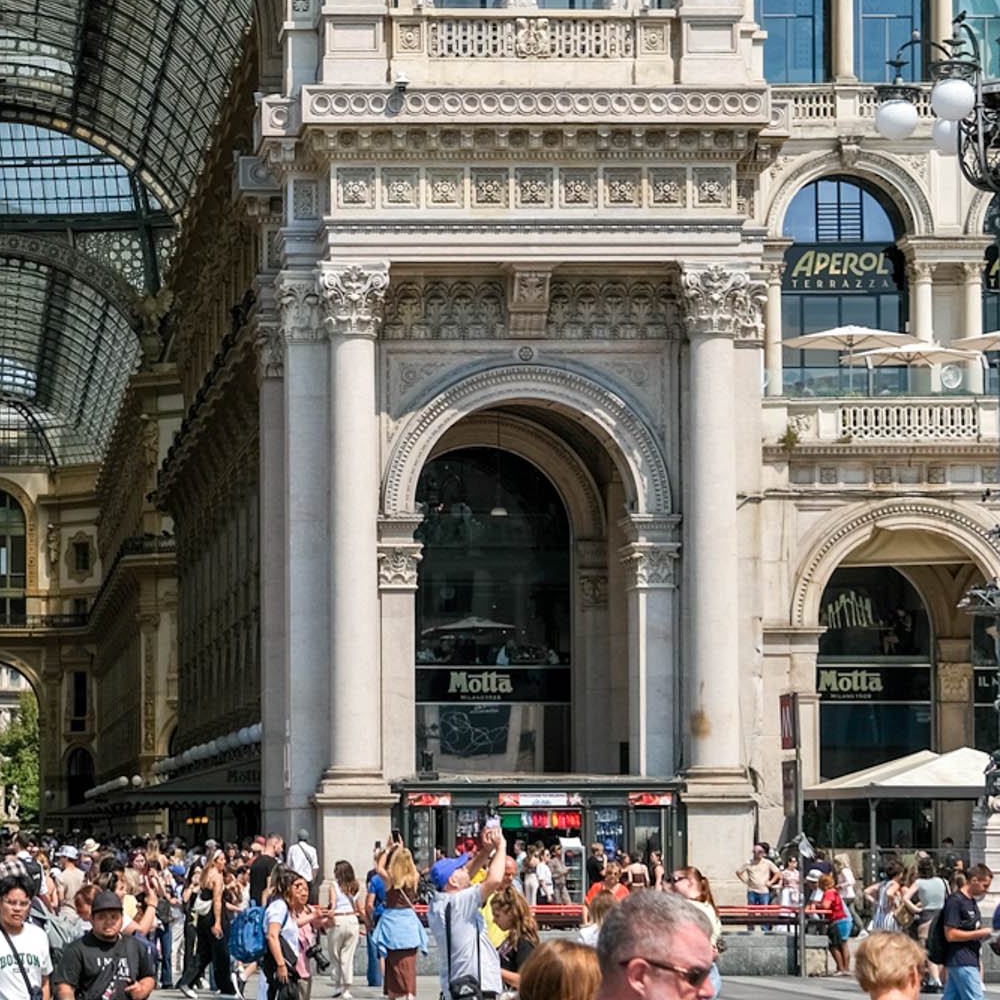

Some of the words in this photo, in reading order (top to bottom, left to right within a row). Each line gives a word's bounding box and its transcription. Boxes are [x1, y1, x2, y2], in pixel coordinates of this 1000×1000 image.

[792, 250, 889, 277] APEROL
[792, 280, 889, 289] TERRAZZA
[448, 671, 514, 693] Motta
[818, 670, 883, 692] Motta
